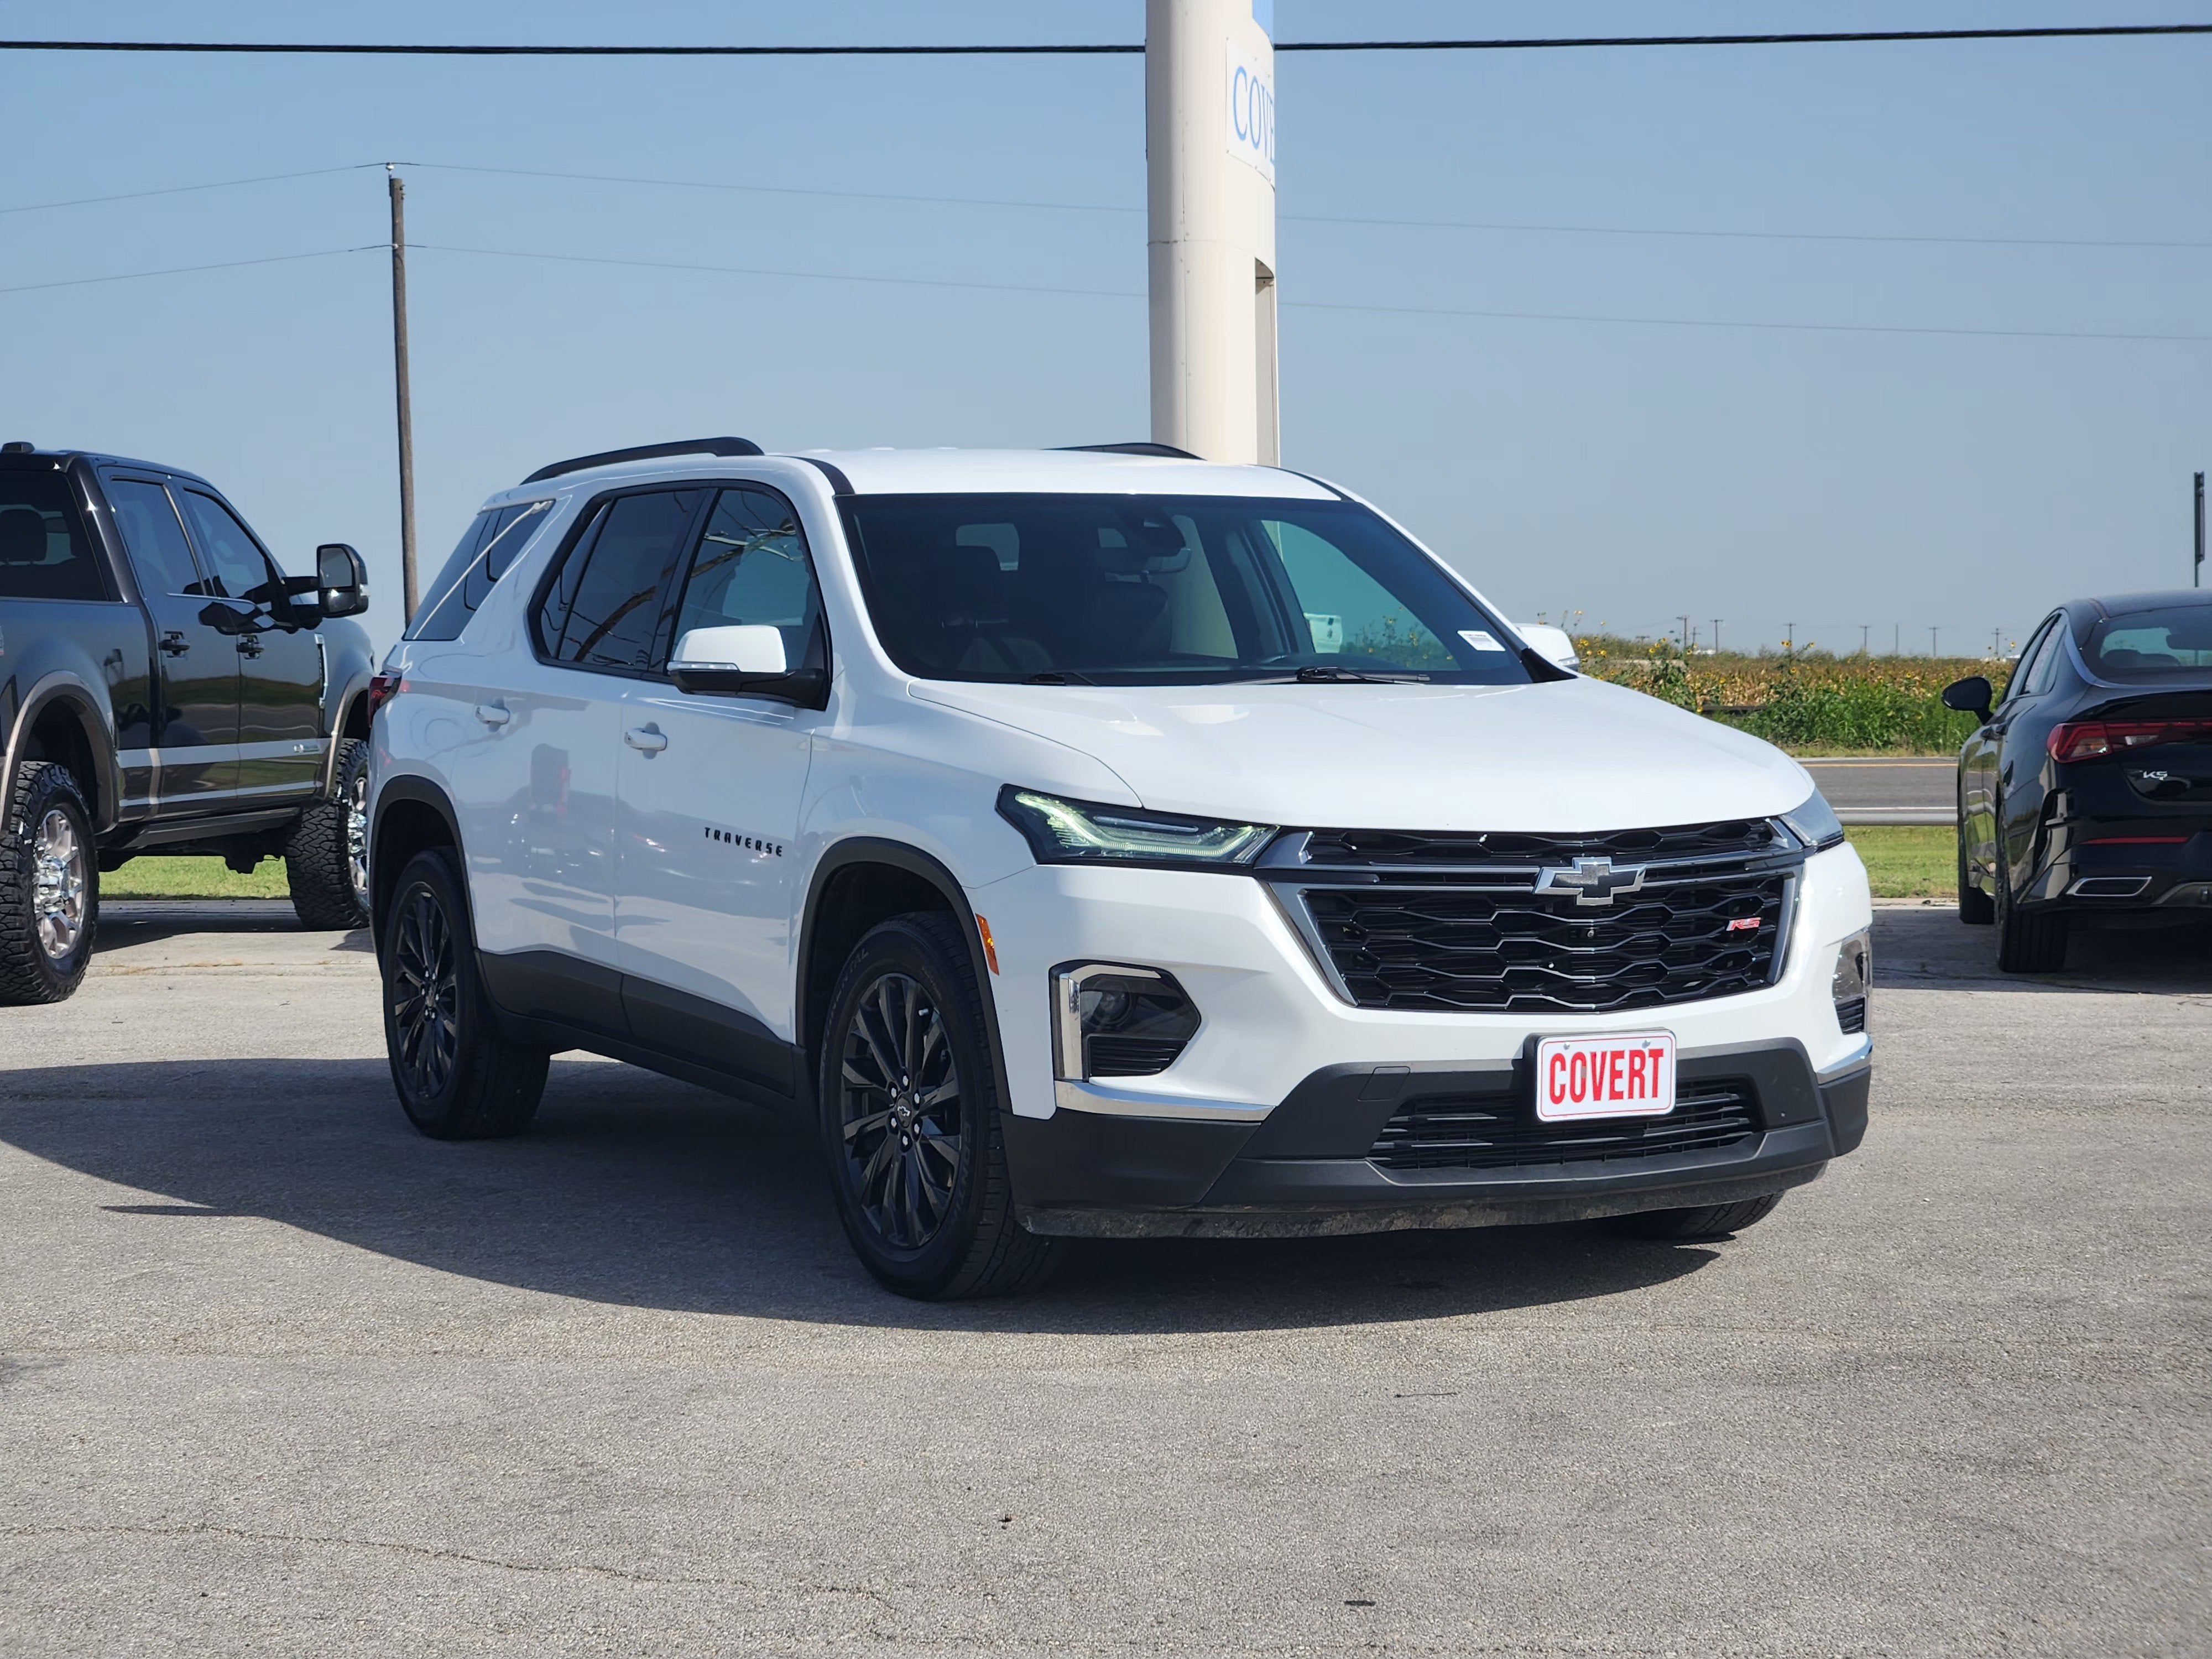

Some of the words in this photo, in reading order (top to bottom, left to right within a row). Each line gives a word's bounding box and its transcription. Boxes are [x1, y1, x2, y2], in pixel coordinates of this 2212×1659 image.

[705, 827, 782, 857] TRAVERSE
[1726, 917, 1761, 931] RS
[1549, 1048, 1664, 1104] COVERT
